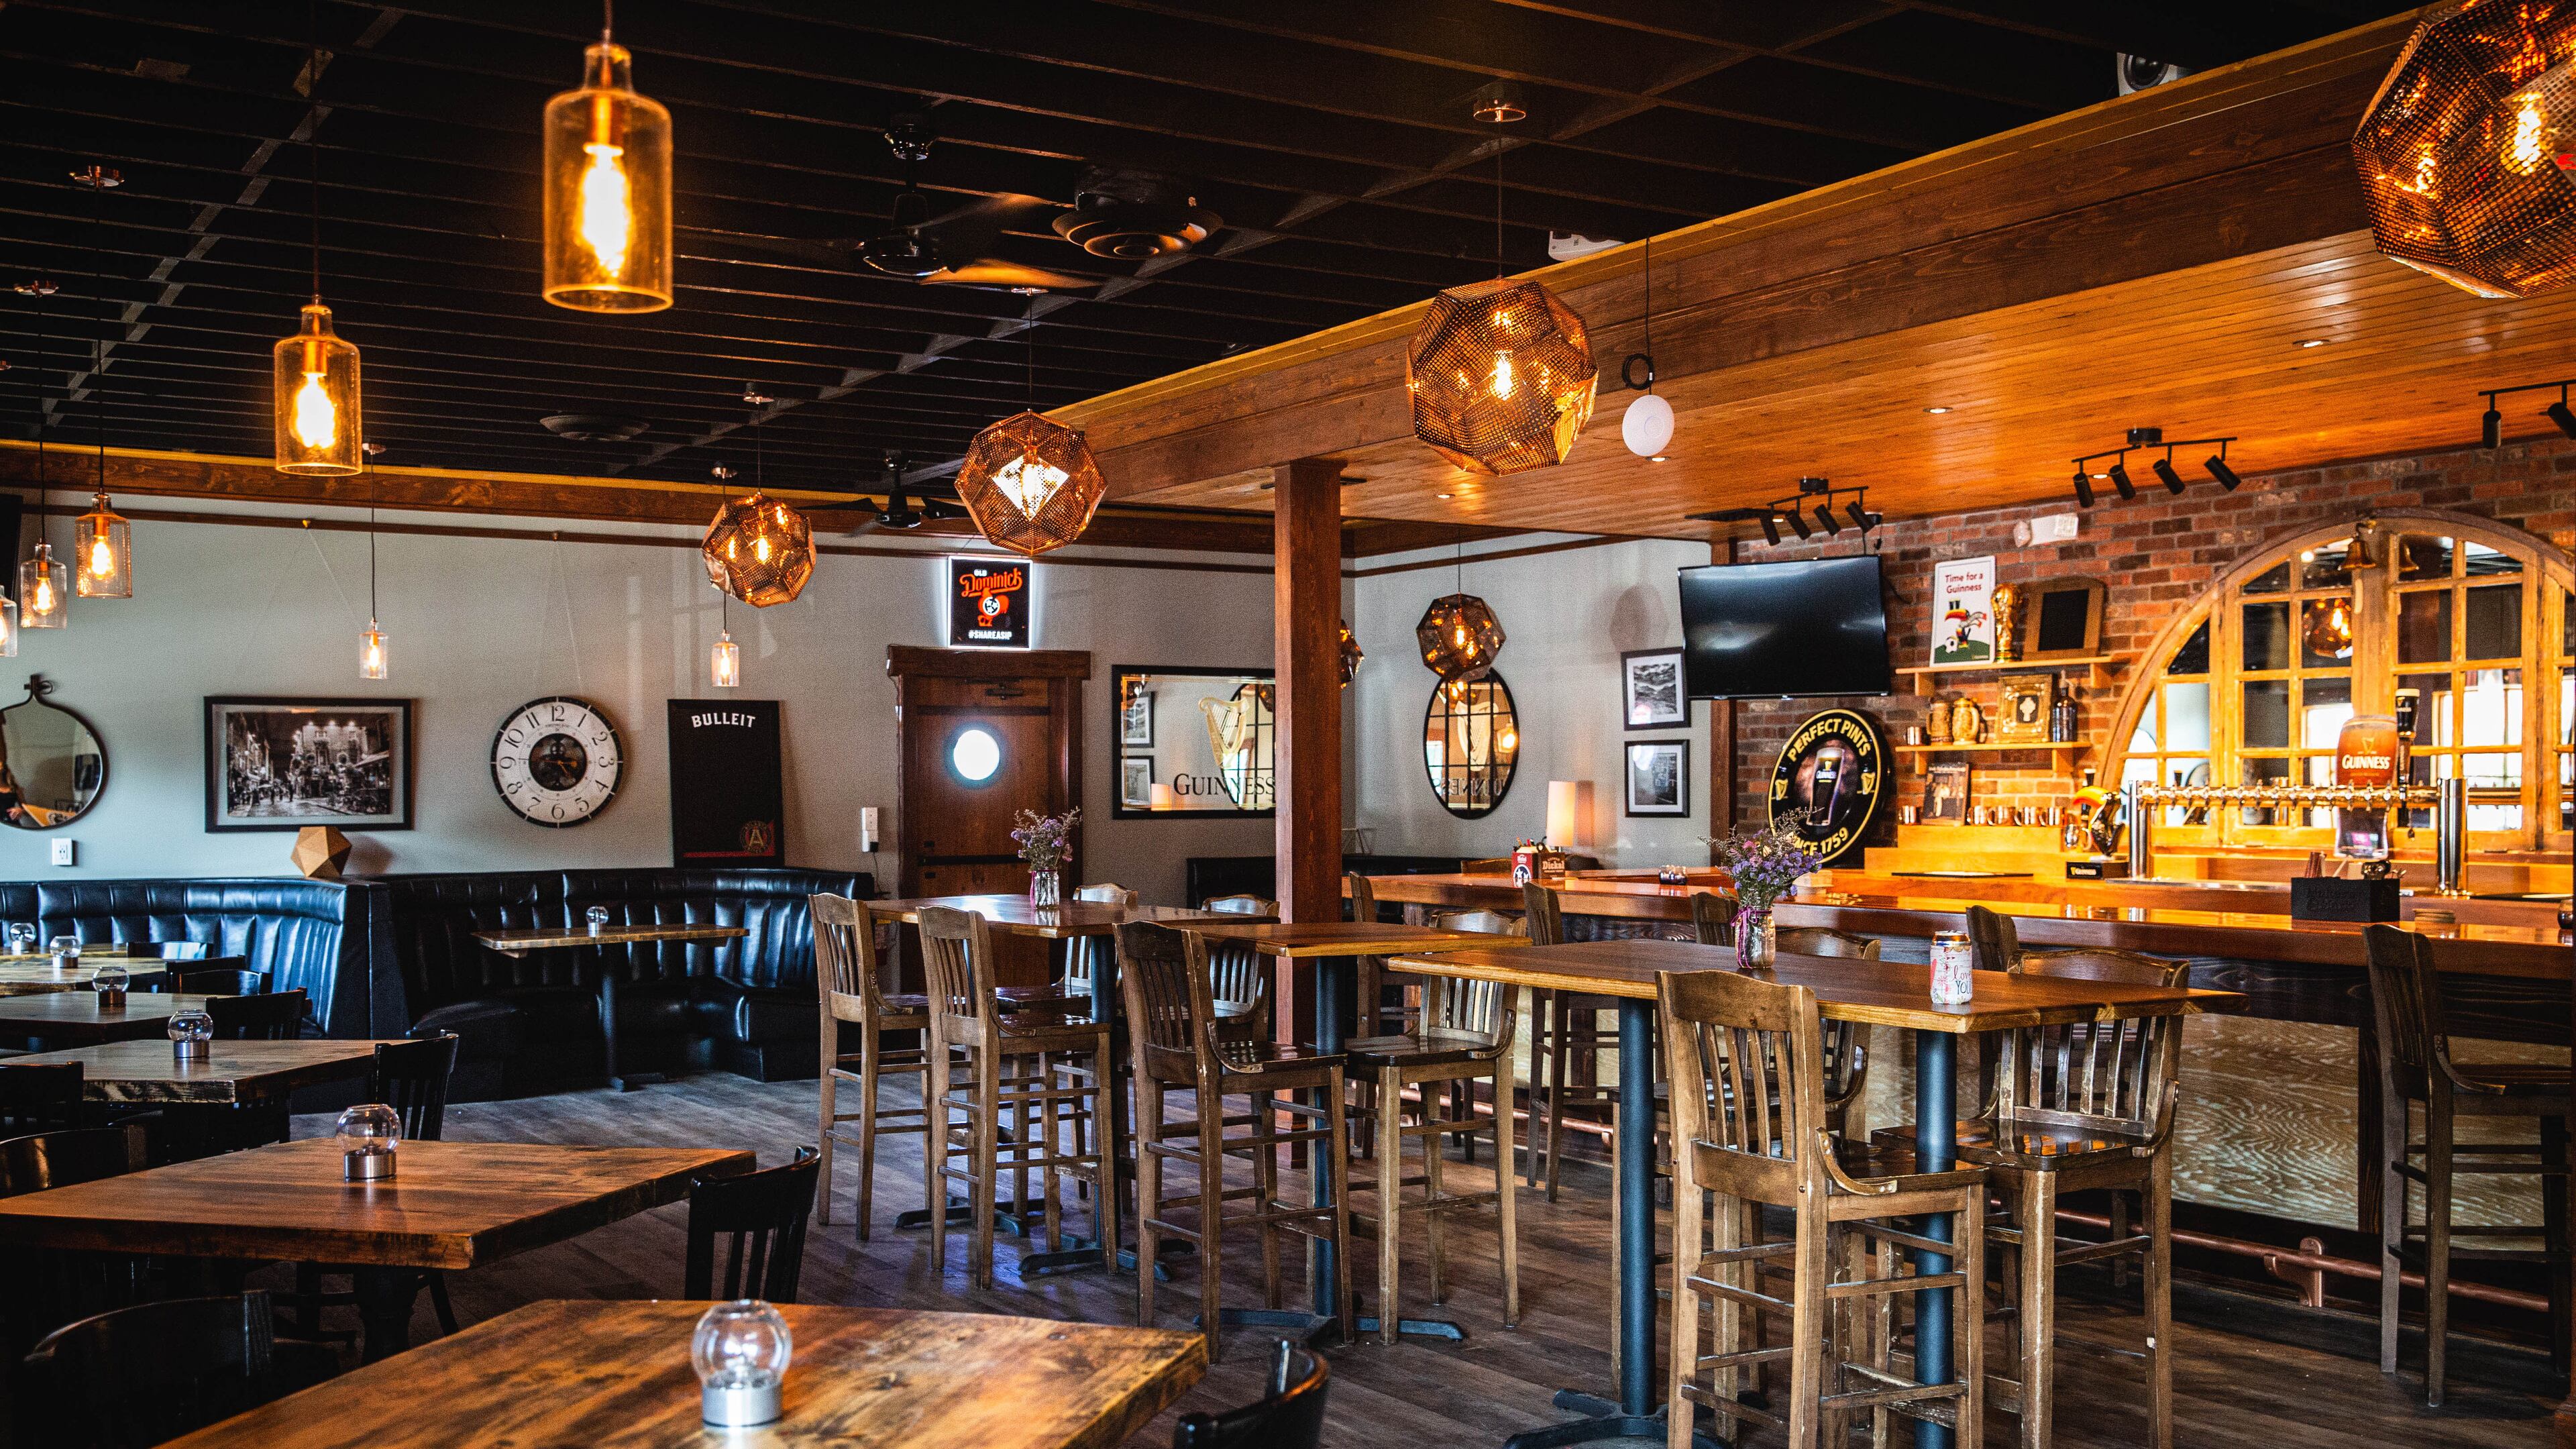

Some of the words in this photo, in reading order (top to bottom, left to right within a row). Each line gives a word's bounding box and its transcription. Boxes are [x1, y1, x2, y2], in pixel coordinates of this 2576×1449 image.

[959, 568, 1022, 597] Dominick
[1945, 574, 1964, 582] Time
[1966, 572, 1977, 580] for
[1946, 584, 1982, 594] Guinness
[526, 712, 540, 729] 11
[551, 705, 565, 722] 12
[578, 713, 587, 727] 1
[691, 712, 756, 728] BULLEIT
[504, 729, 525, 748] 10
[592, 731, 608, 746] 2
[1787, 718, 1841, 762] PERFECT
[1840, 719, 1871, 757] PINTS
[499, 756, 517, 769] 9
[598, 756, 614, 768] 3
[2342, 754, 2391, 769] GUINNESS
[506, 781, 523, 795] 8
[594, 780, 609, 792] 4
[1174, 773, 1275, 796] GUINNESS
[527, 796, 541, 812] 7
[551, 803, 565, 820] 6
[575, 797, 590, 812] 5
[1820, 826, 1849, 854] 1759
[1955, 980, 1971, 994] YOU
